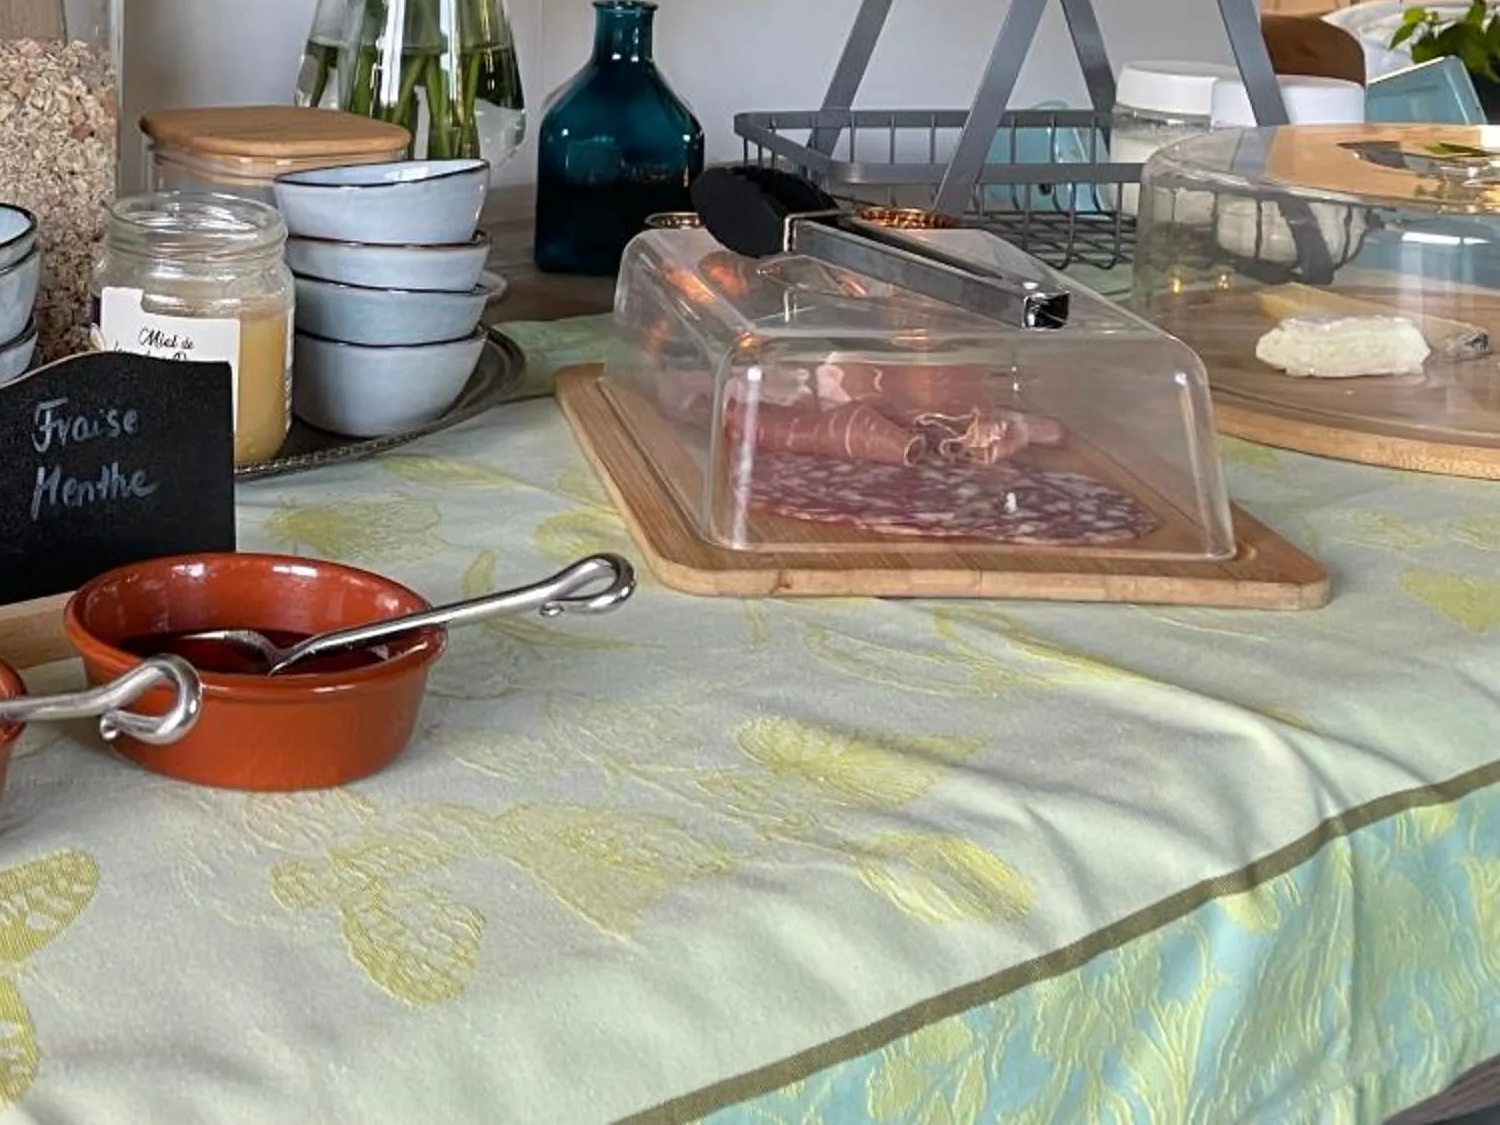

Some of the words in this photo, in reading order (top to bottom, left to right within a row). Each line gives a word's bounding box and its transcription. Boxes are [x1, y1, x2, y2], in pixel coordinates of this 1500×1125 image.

[137, 326, 178, 350] Miel
[181, 338, 196, 350] de
[31, 397, 140, 453] Fraise
[30, 461, 160, 522] Menthe
